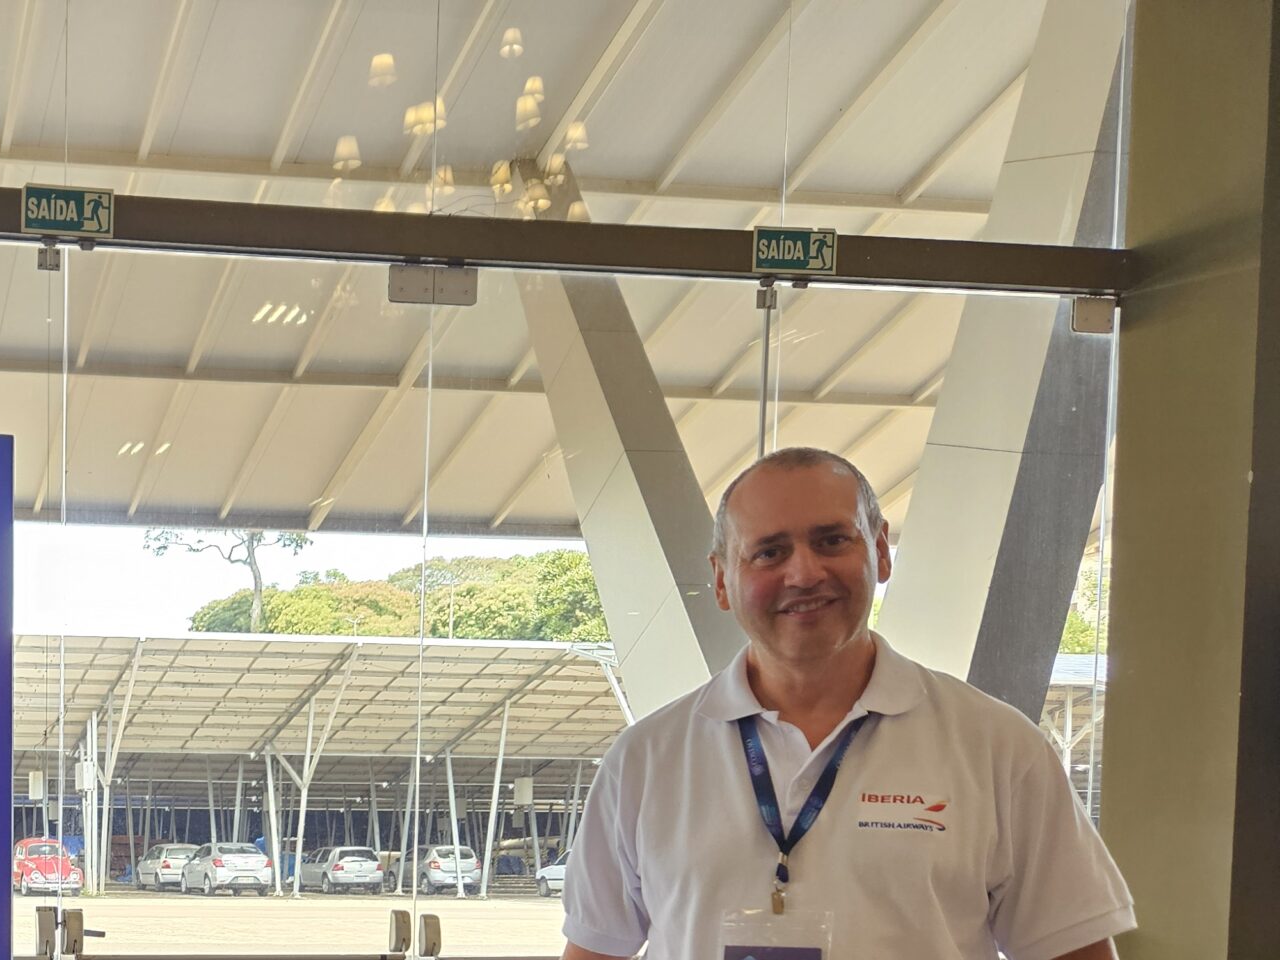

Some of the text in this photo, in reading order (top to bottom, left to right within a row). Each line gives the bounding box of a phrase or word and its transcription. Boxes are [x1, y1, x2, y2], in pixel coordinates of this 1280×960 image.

[27, 193, 78, 222] SAÍDA
[758, 235, 804, 261] SAÍDA
[861, 792, 925, 805] IBERIA
